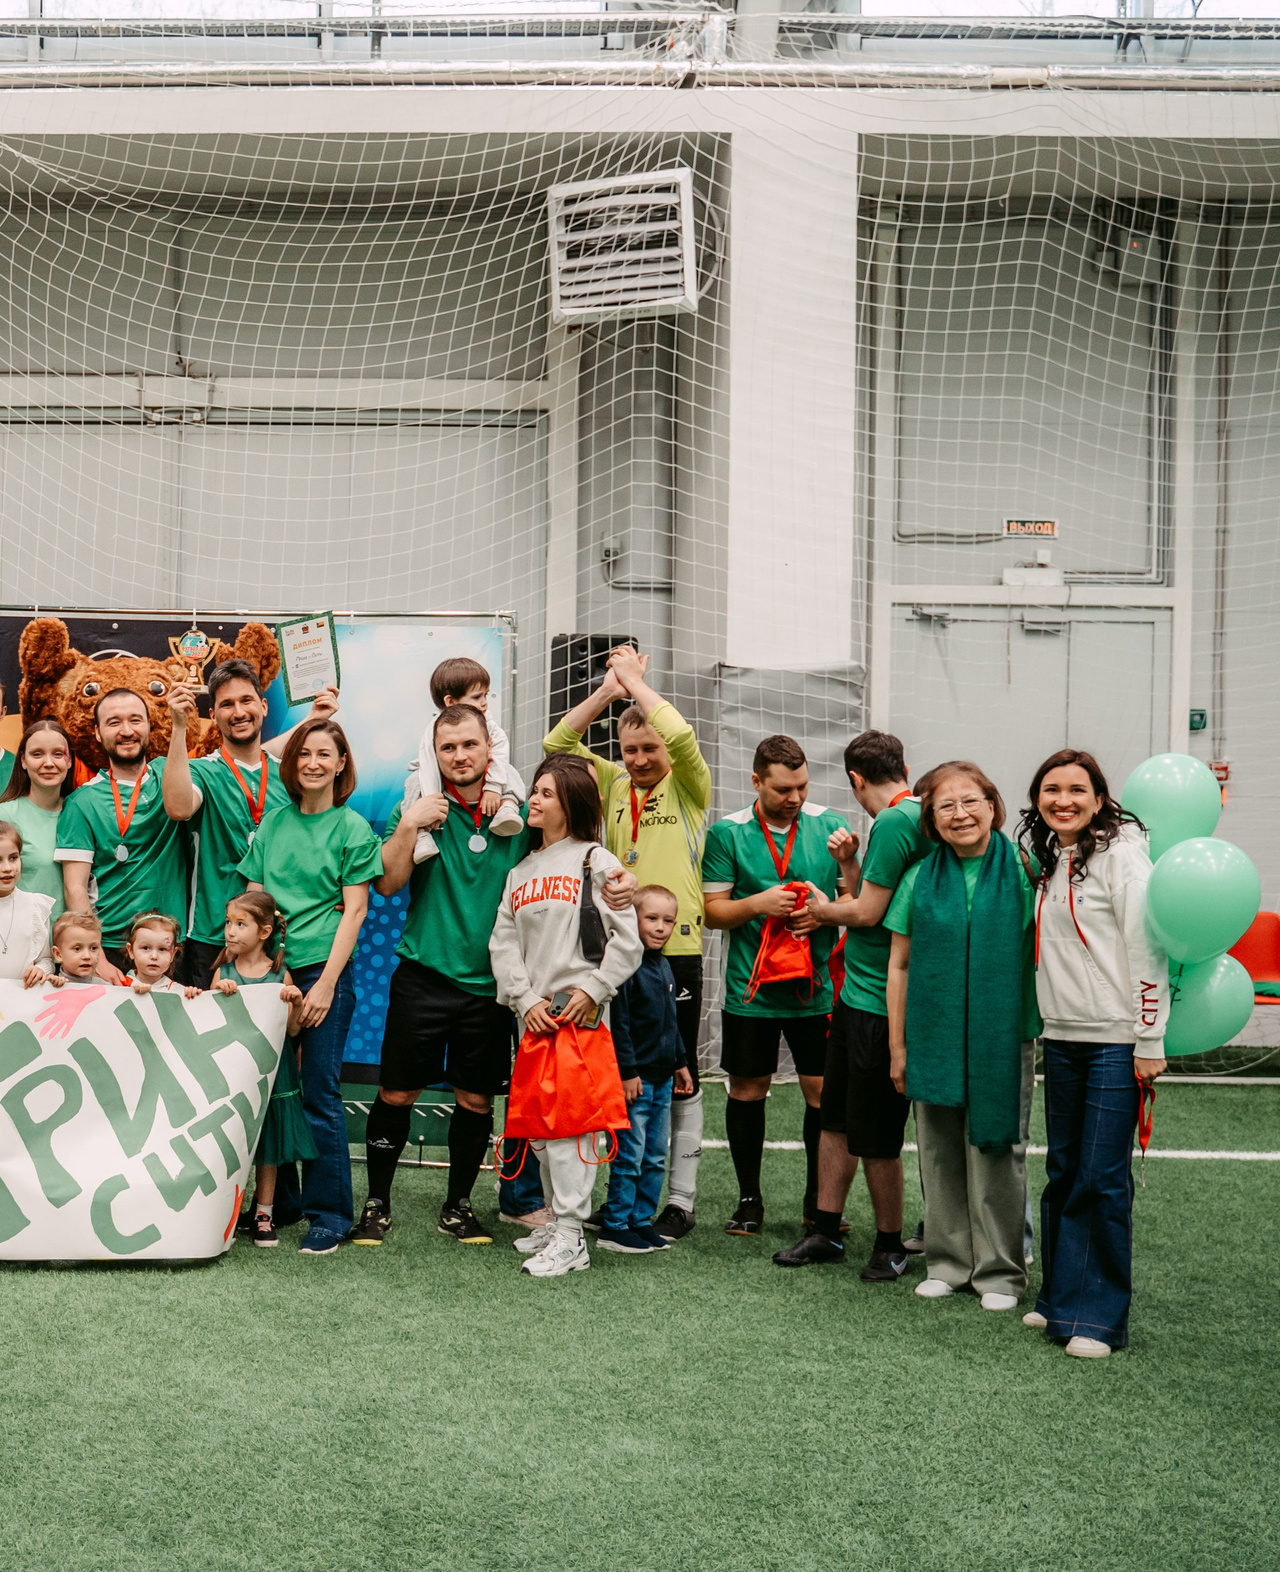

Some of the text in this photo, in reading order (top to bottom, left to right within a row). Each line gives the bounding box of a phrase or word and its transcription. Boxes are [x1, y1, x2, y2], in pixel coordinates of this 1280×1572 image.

[1009, 521, 1052, 534] ВЫХОД
[292, 637, 323, 650] ДИПЛОМ
[511, 875, 581, 918] ELLNESS
[1139, 980, 1159, 1026] CITY
[90, 1075, 269, 1255] СИТИ
